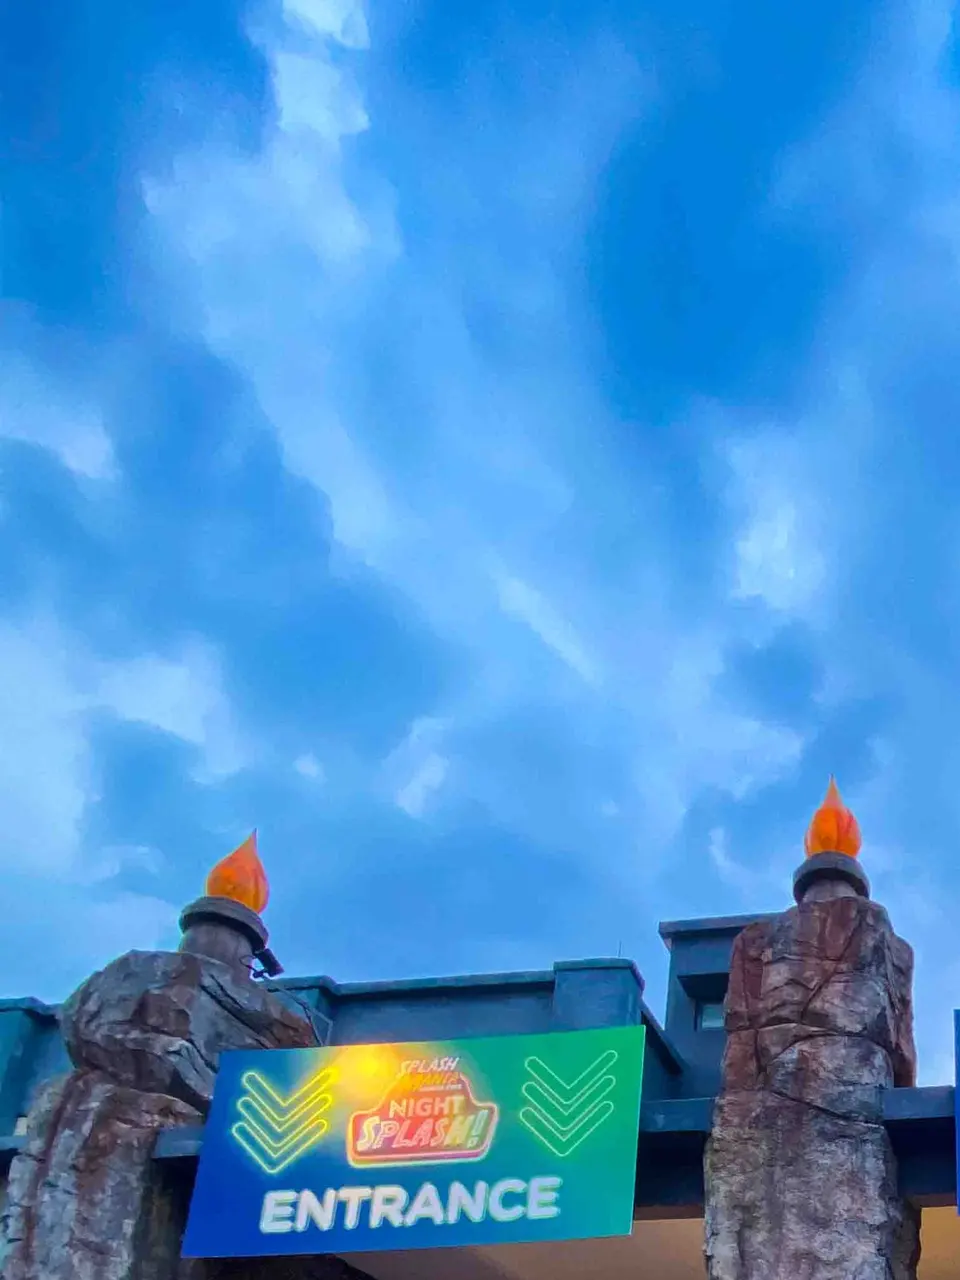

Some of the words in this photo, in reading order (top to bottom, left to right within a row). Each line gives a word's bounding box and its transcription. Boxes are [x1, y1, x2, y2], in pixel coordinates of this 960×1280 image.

[396, 1056, 460, 1078] SPLASH
[388, 1095, 465, 1118] NIGHT
[356, 1109, 489, 1151] SPLASH!
[260, 1175, 563, 1234] ENTRANCE
